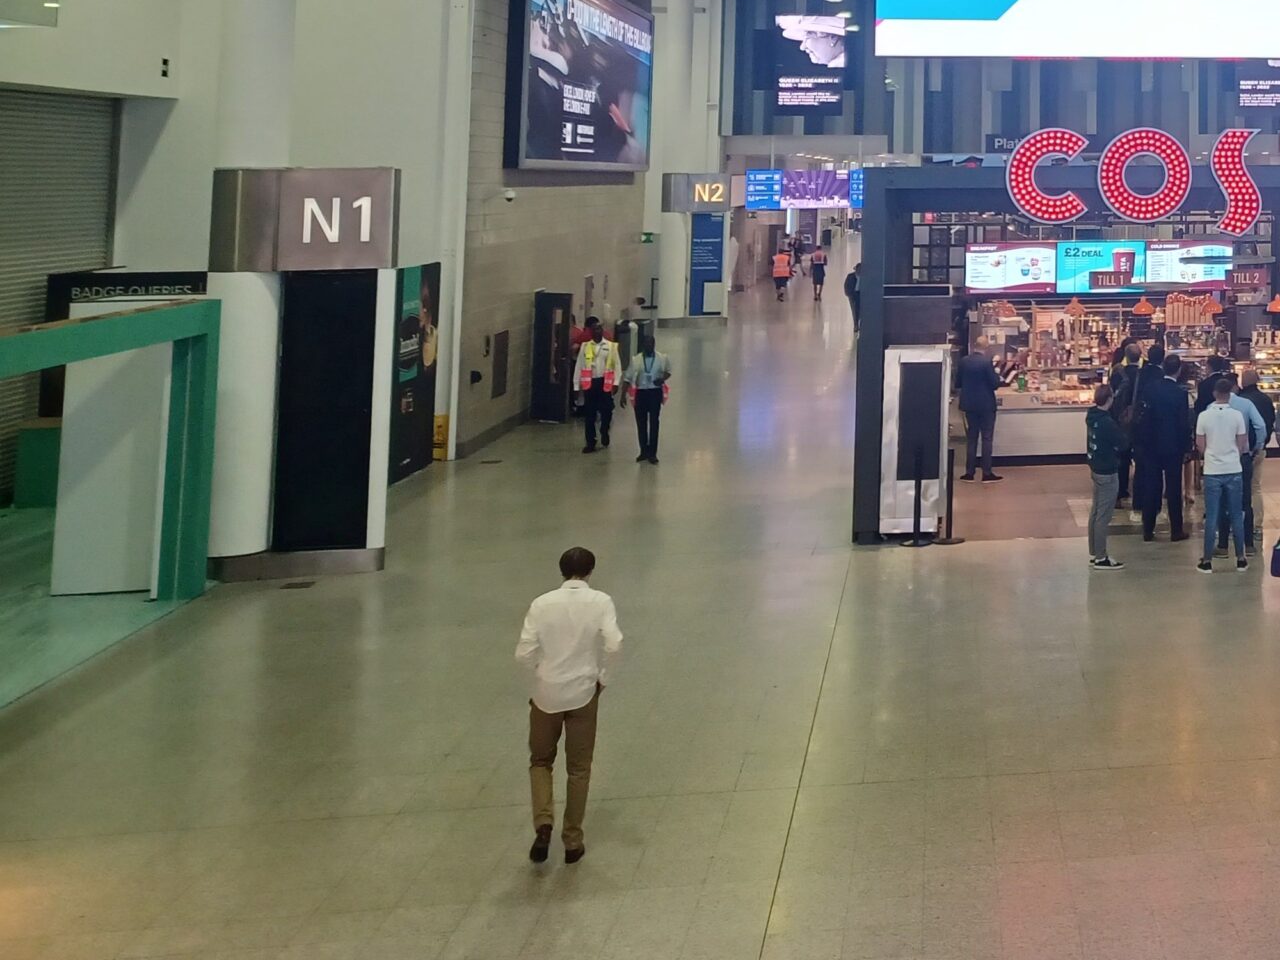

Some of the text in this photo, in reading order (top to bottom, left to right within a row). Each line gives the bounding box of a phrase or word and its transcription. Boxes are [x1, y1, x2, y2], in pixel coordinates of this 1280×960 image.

[695, 184, 724, 202] N2
[302, 196, 372, 243] N1
[1064, 248, 1080, 257] £2
[1097, 275, 1124, 286] TILL 1
[1233, 273, 1259, 284] TILL 2
[71, 287, 125, 299] BADGE
